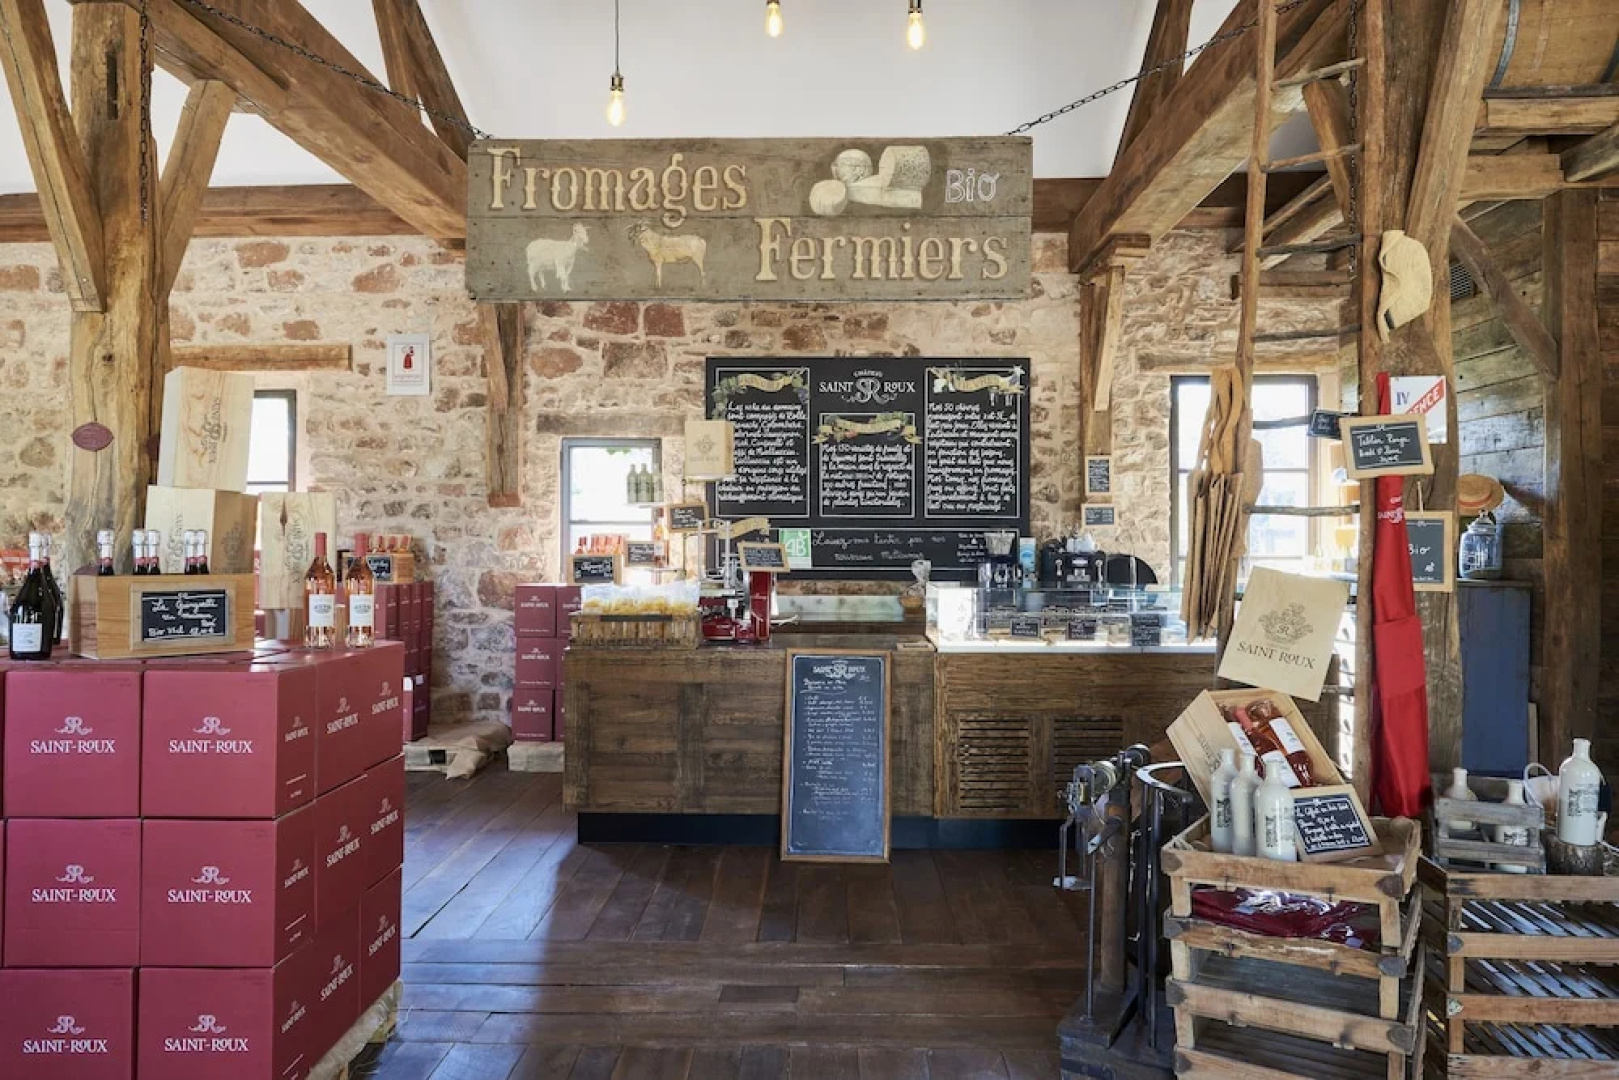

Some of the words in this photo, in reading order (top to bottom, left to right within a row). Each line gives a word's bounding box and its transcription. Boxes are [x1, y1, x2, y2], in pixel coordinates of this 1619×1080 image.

[486, 147, 748, 227] Fromages
[945, 169, 999, 204] Bio
[754, 216, 1009, 282] Fermiers
[819, 381, 854, 393] SAINT
[883, 381, 916, 393] ROUX
[1396, 391, 1410, 406] IV
[1236, 641, 1276, 660] SAINT
[1278, 651, 1316, 670] ROUX
[30, 740, 116, 754] SAINT-ROUX
[169, 740, 253, 754] SAINT-ROUX
[32, 888, 116, 903] SAINT-ROUX
[168, 889, 252, 904] SAINT-ROUX
[23, 1039, 108, 1054] SAINT-ROUX
[164, 1038, 248, 1052] SAINT-ROUX
